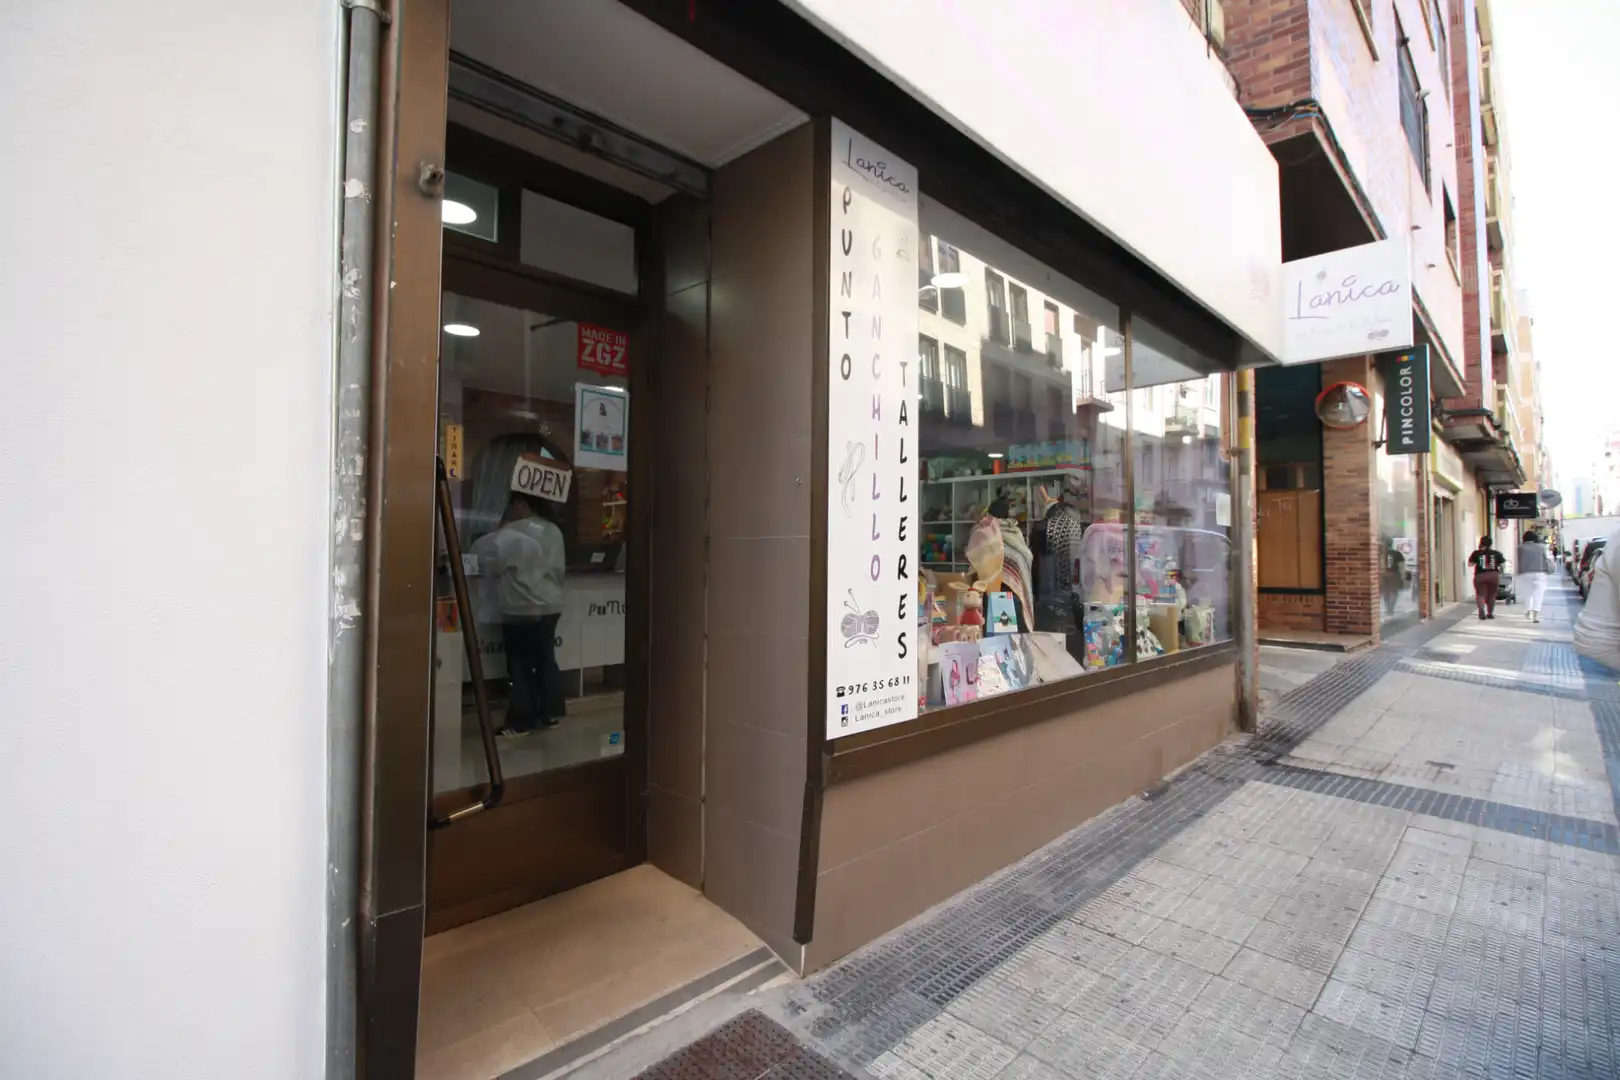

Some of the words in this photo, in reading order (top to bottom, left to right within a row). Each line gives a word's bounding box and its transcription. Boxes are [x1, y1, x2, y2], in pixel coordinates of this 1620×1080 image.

[841, 137, 910, 193] Lanica
[840, 186, 853, 381] PUNTO
[1287, 274, 1400, 320] Lanica
[581, 326, 612, 344] MADE
[615, 334, 626, 346] IN
[581, 338, 625, 369] ZGZ
[870, 235, 884, 582] GANCHILLO
[1400, 365, 1414, 445] PINCOLOR
[518, 464, 567, 499] OPEN
[896, 361, 909, 659] TALLERES
[848, 682, 868, 695] 976
[872, 679, 884, 691] 35
[888, 676, 899, 688] 68
[903, 675, 910, 685] 11
[855, 694, 905, 711] @Lanicastore
